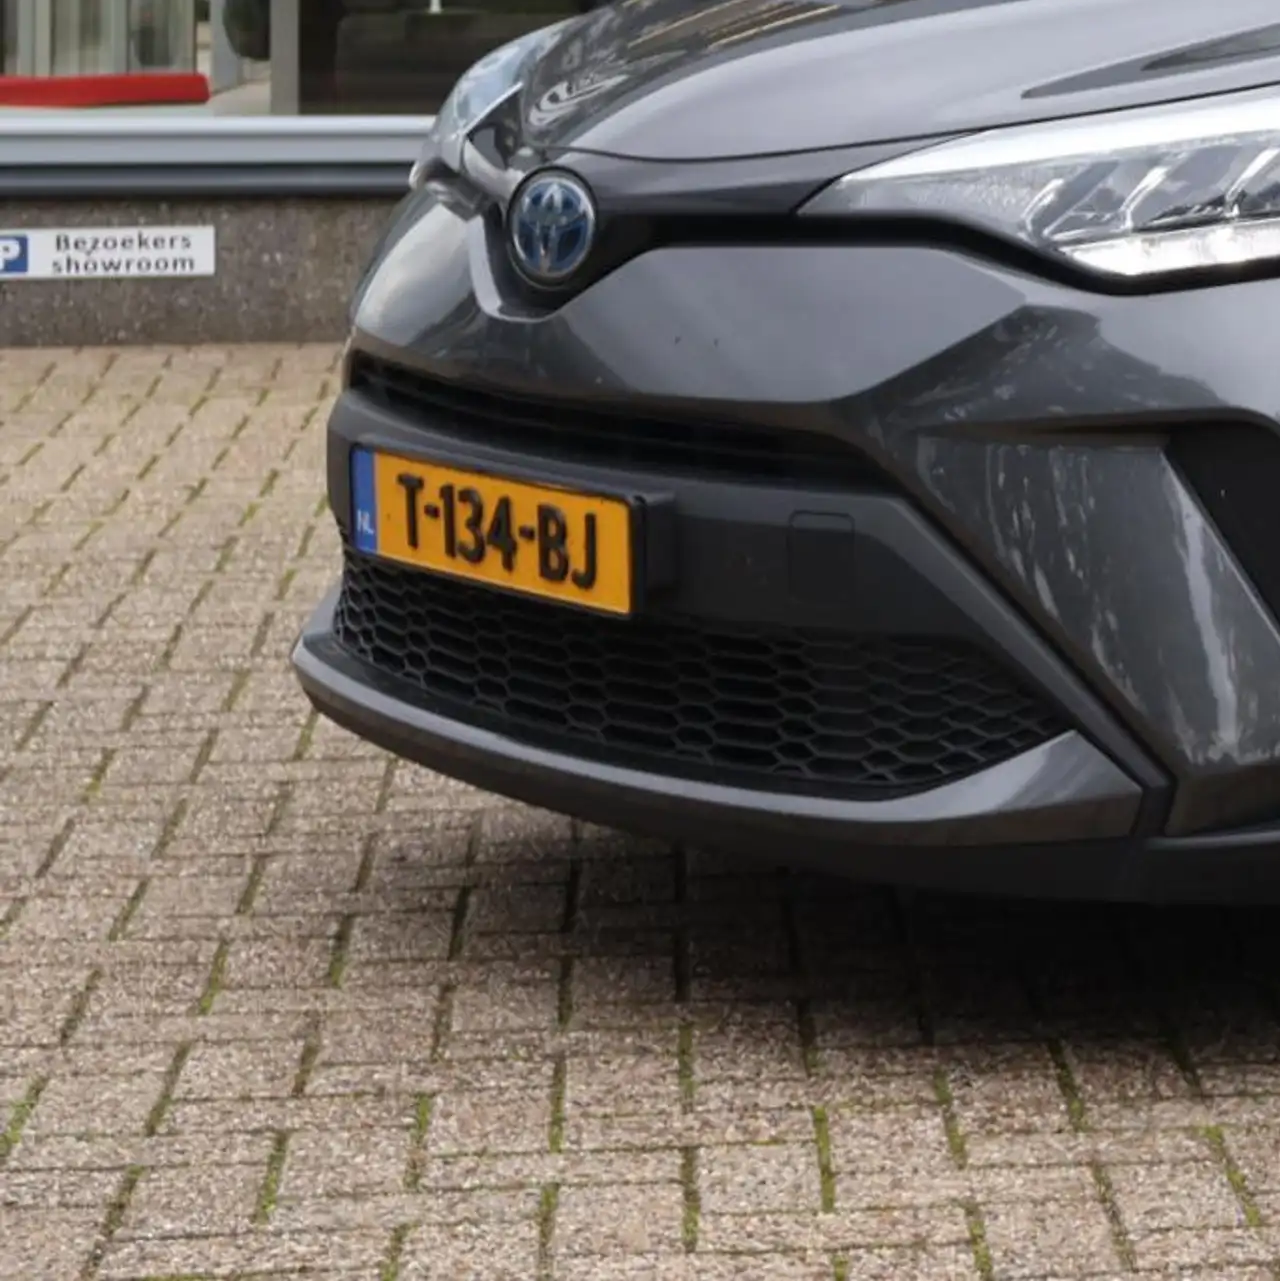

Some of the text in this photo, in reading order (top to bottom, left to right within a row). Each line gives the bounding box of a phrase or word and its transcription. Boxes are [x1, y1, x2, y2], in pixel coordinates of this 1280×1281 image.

[56, 230, 191, 252] Bezoekers
[52, 256, 195, 274] showroom
[397, 472, 597, 590] T-134-BJ
